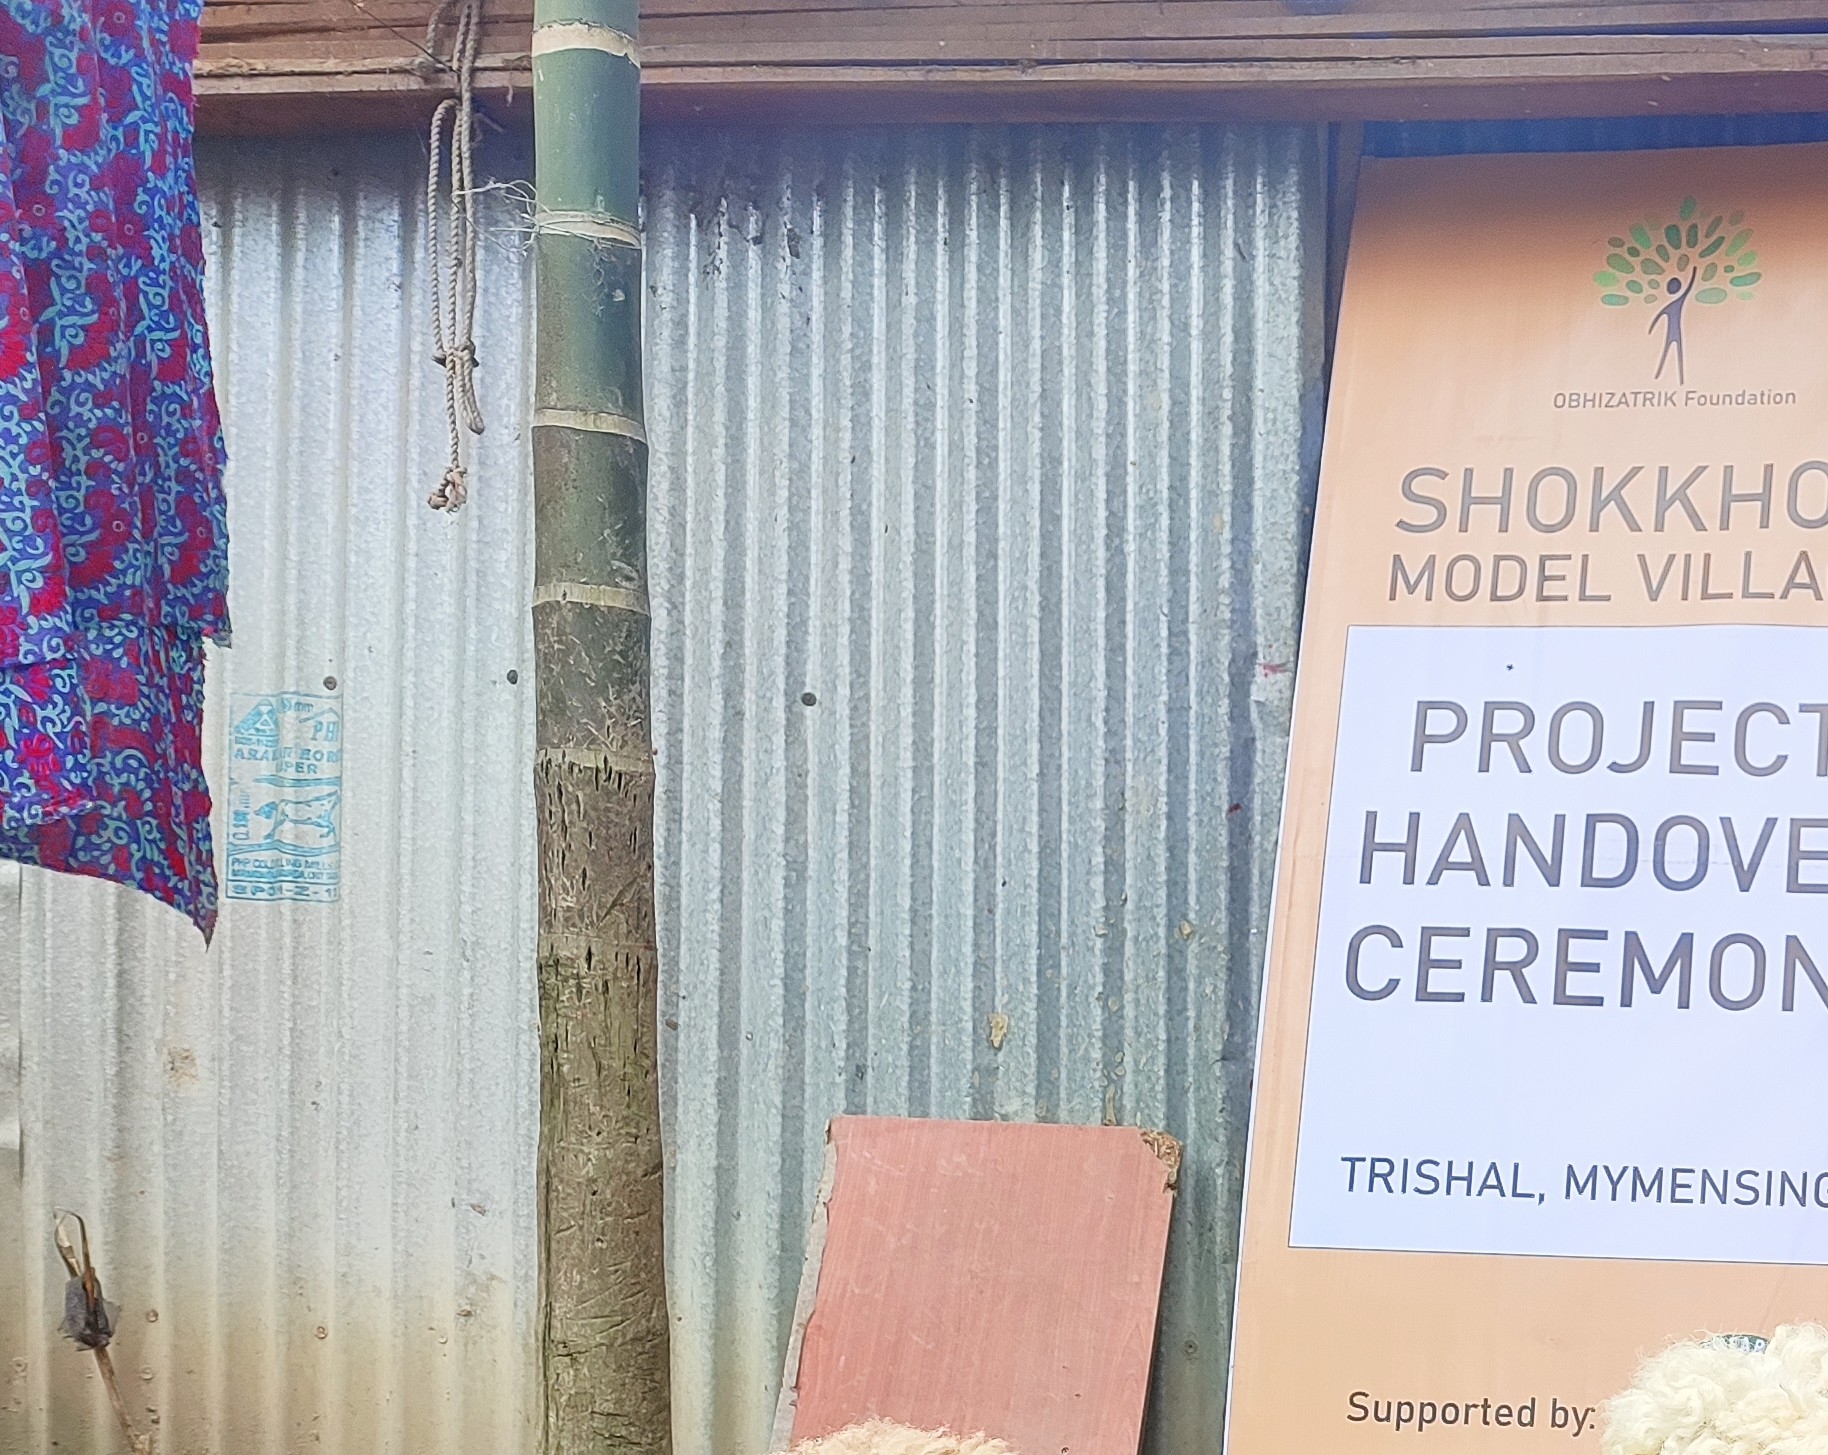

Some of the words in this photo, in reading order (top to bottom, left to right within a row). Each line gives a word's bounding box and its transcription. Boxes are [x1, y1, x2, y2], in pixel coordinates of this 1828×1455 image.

[1552, 390, 1678, 409] OBHIZATRIK
[1684, 388, 1797, 408] Foundation
[1388, 552, 1612, 602] MODEL
[1340, 1155, 1546, 1206] TRISHAL,
[1346, 1390, 1537, 1433] Supported
[1550, 1397, 1597, 1438] by:
